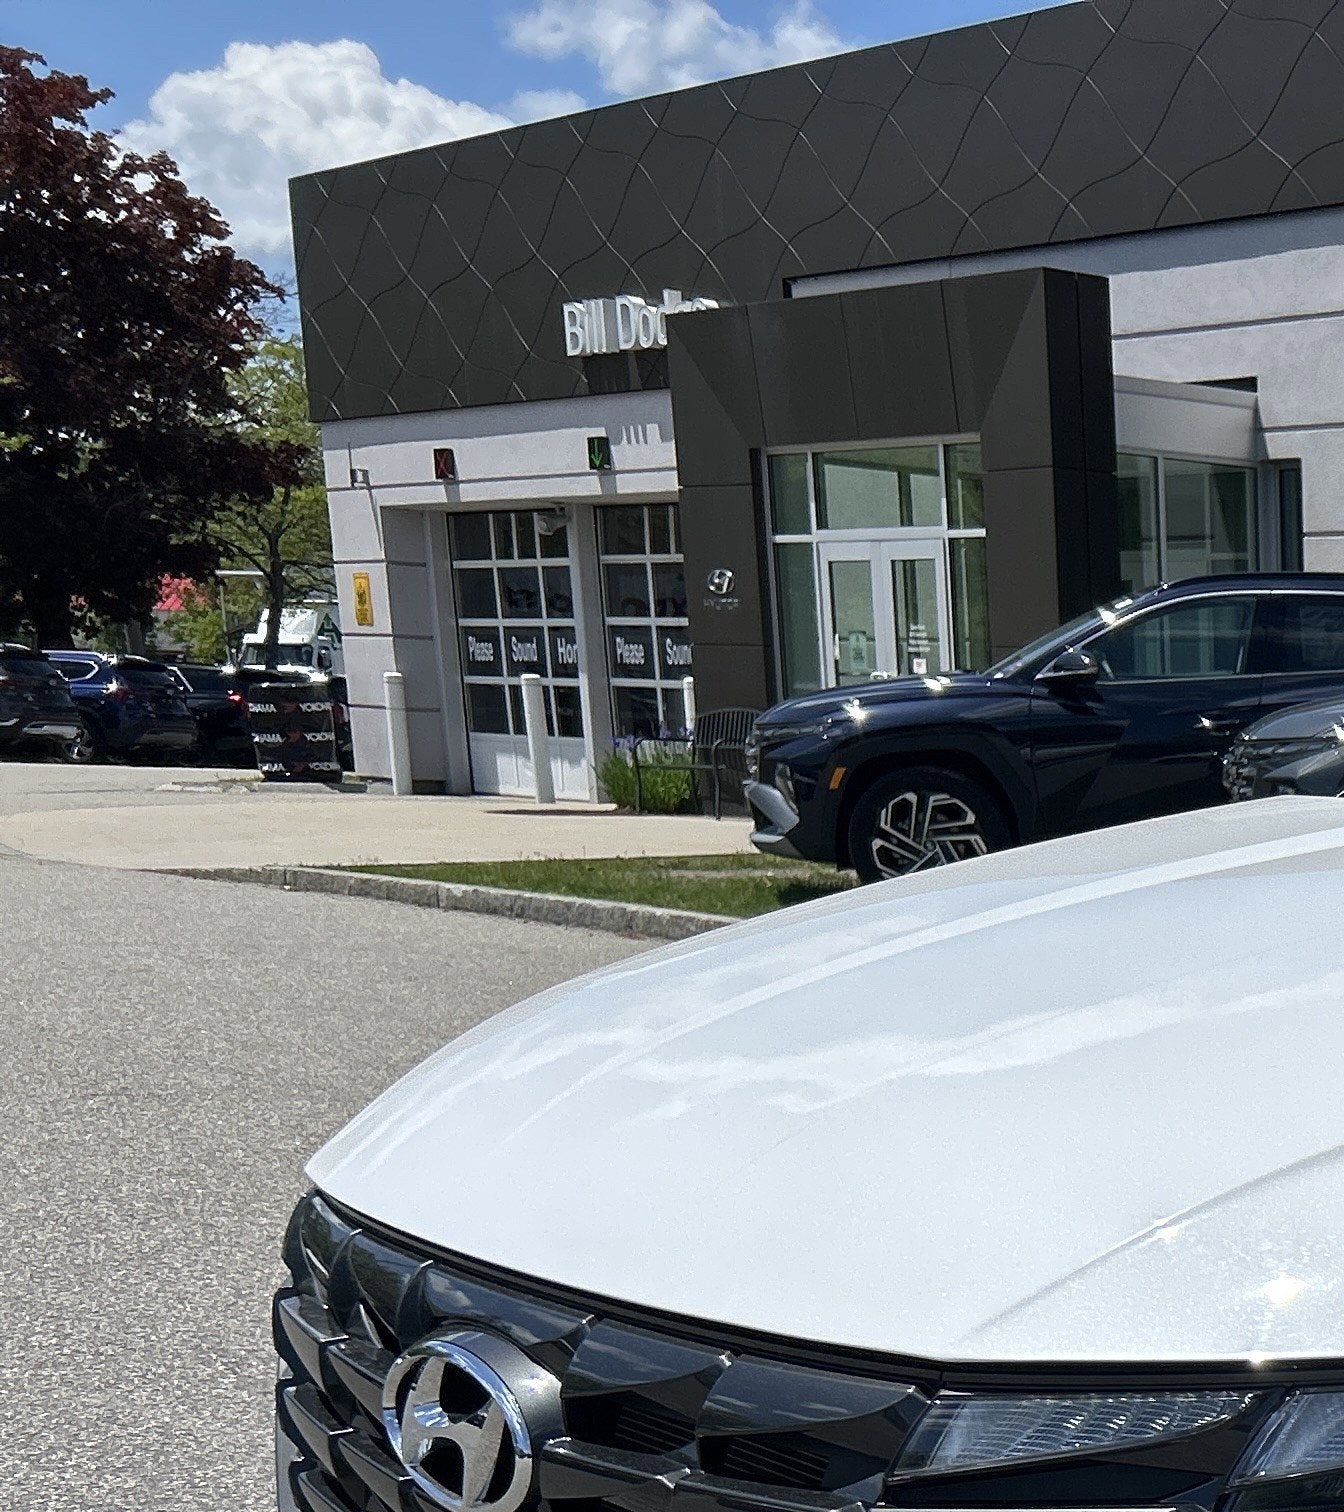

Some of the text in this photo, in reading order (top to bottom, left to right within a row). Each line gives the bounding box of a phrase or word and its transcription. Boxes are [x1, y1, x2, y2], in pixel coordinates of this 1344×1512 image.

[563, 299, 618, 356] Bill
[468, 636, 494, 662] Please
[511, 636, 538, 662] Sound
[615, 637, 645, 664] Please
